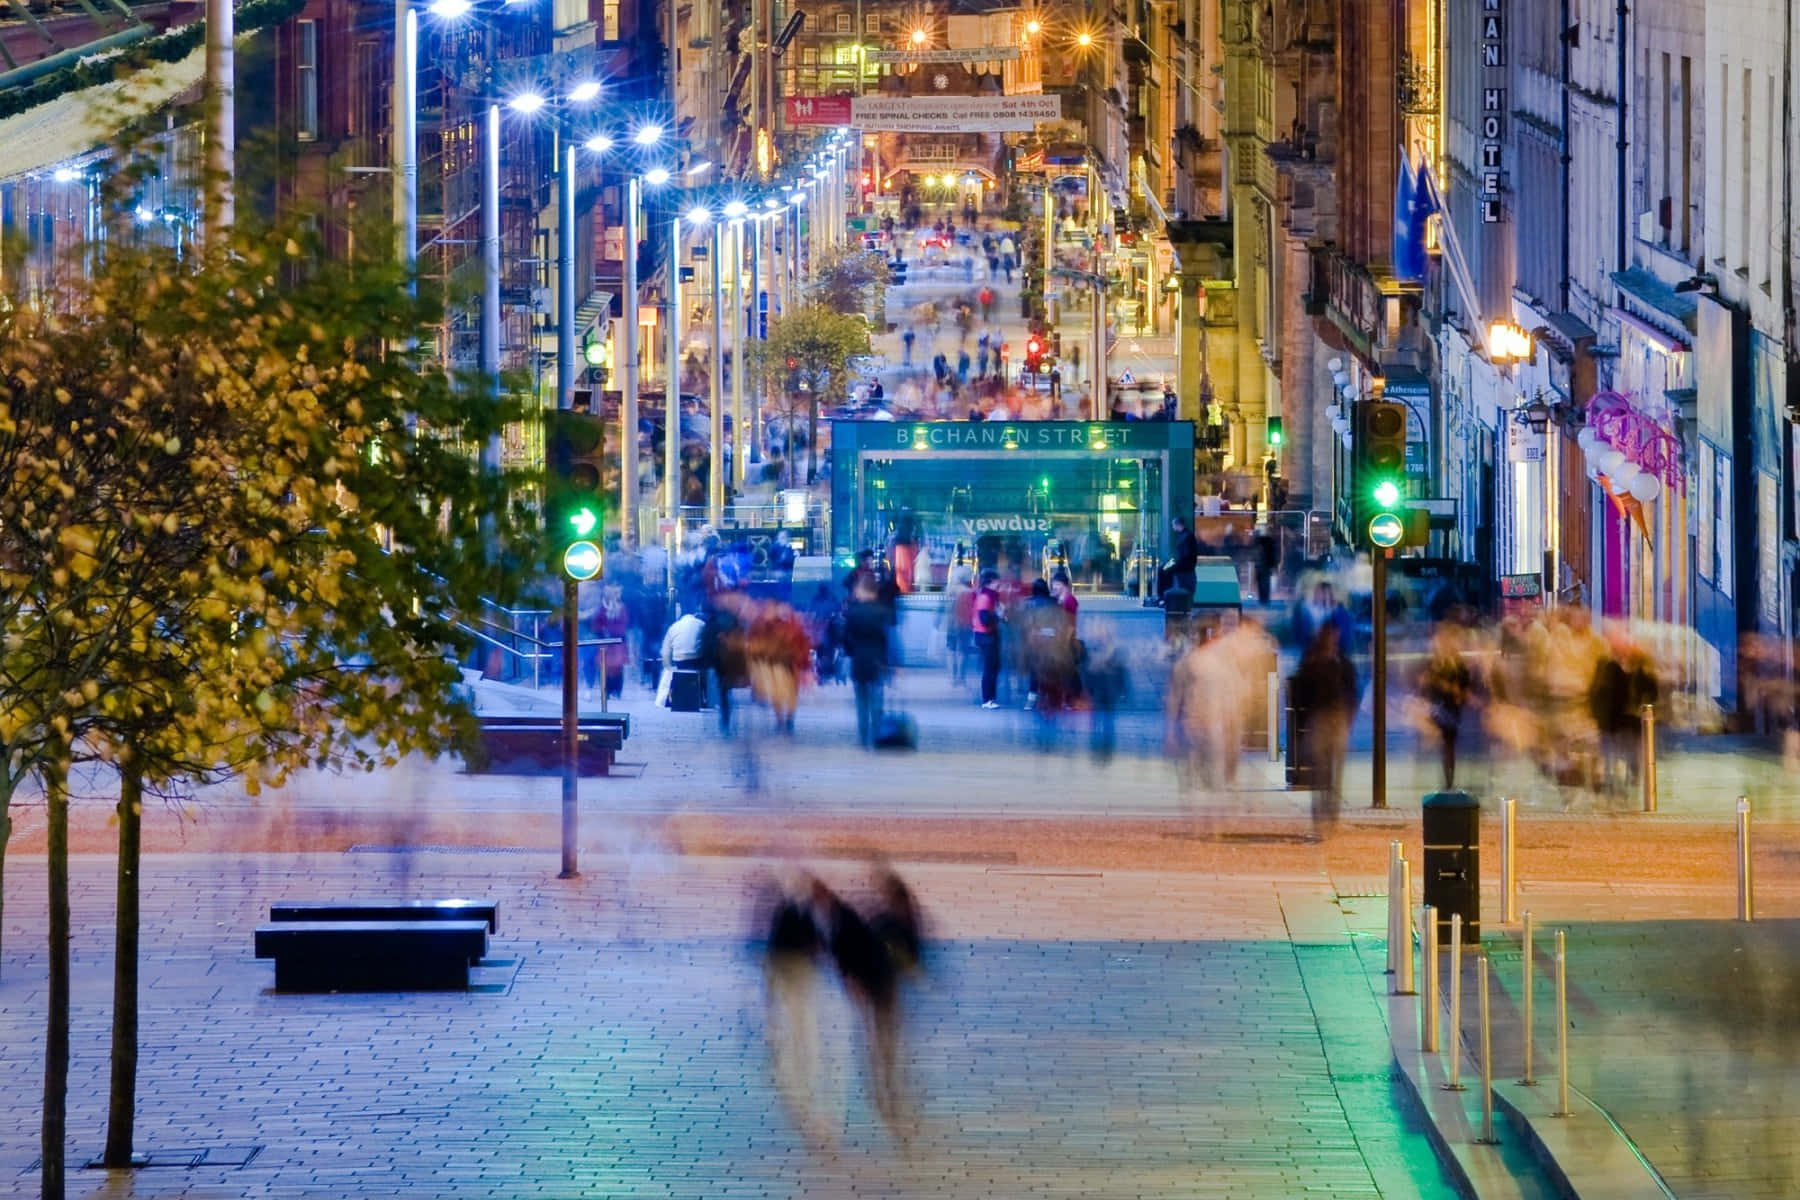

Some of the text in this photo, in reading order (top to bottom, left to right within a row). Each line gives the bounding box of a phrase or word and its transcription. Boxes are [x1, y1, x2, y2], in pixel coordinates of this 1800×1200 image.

[1002, 101, 1017, 109] Sat
[1021, 100, 1036, 108] 4th
[1039, 99, 1054, 108] Oct
[855, 112, 878, 120] FREE
[879, 112, 910, 120] SPINAL
[911, 112, 948, 120] CHECKS
[952, 111, 968, 119] Call
[969, 111, 990, 119] FREE
[993, 110, 1016, 118] 0808
[1485, 89, 1498, 222] HOTEL
[1038, 428, 1132, 444] STREET
